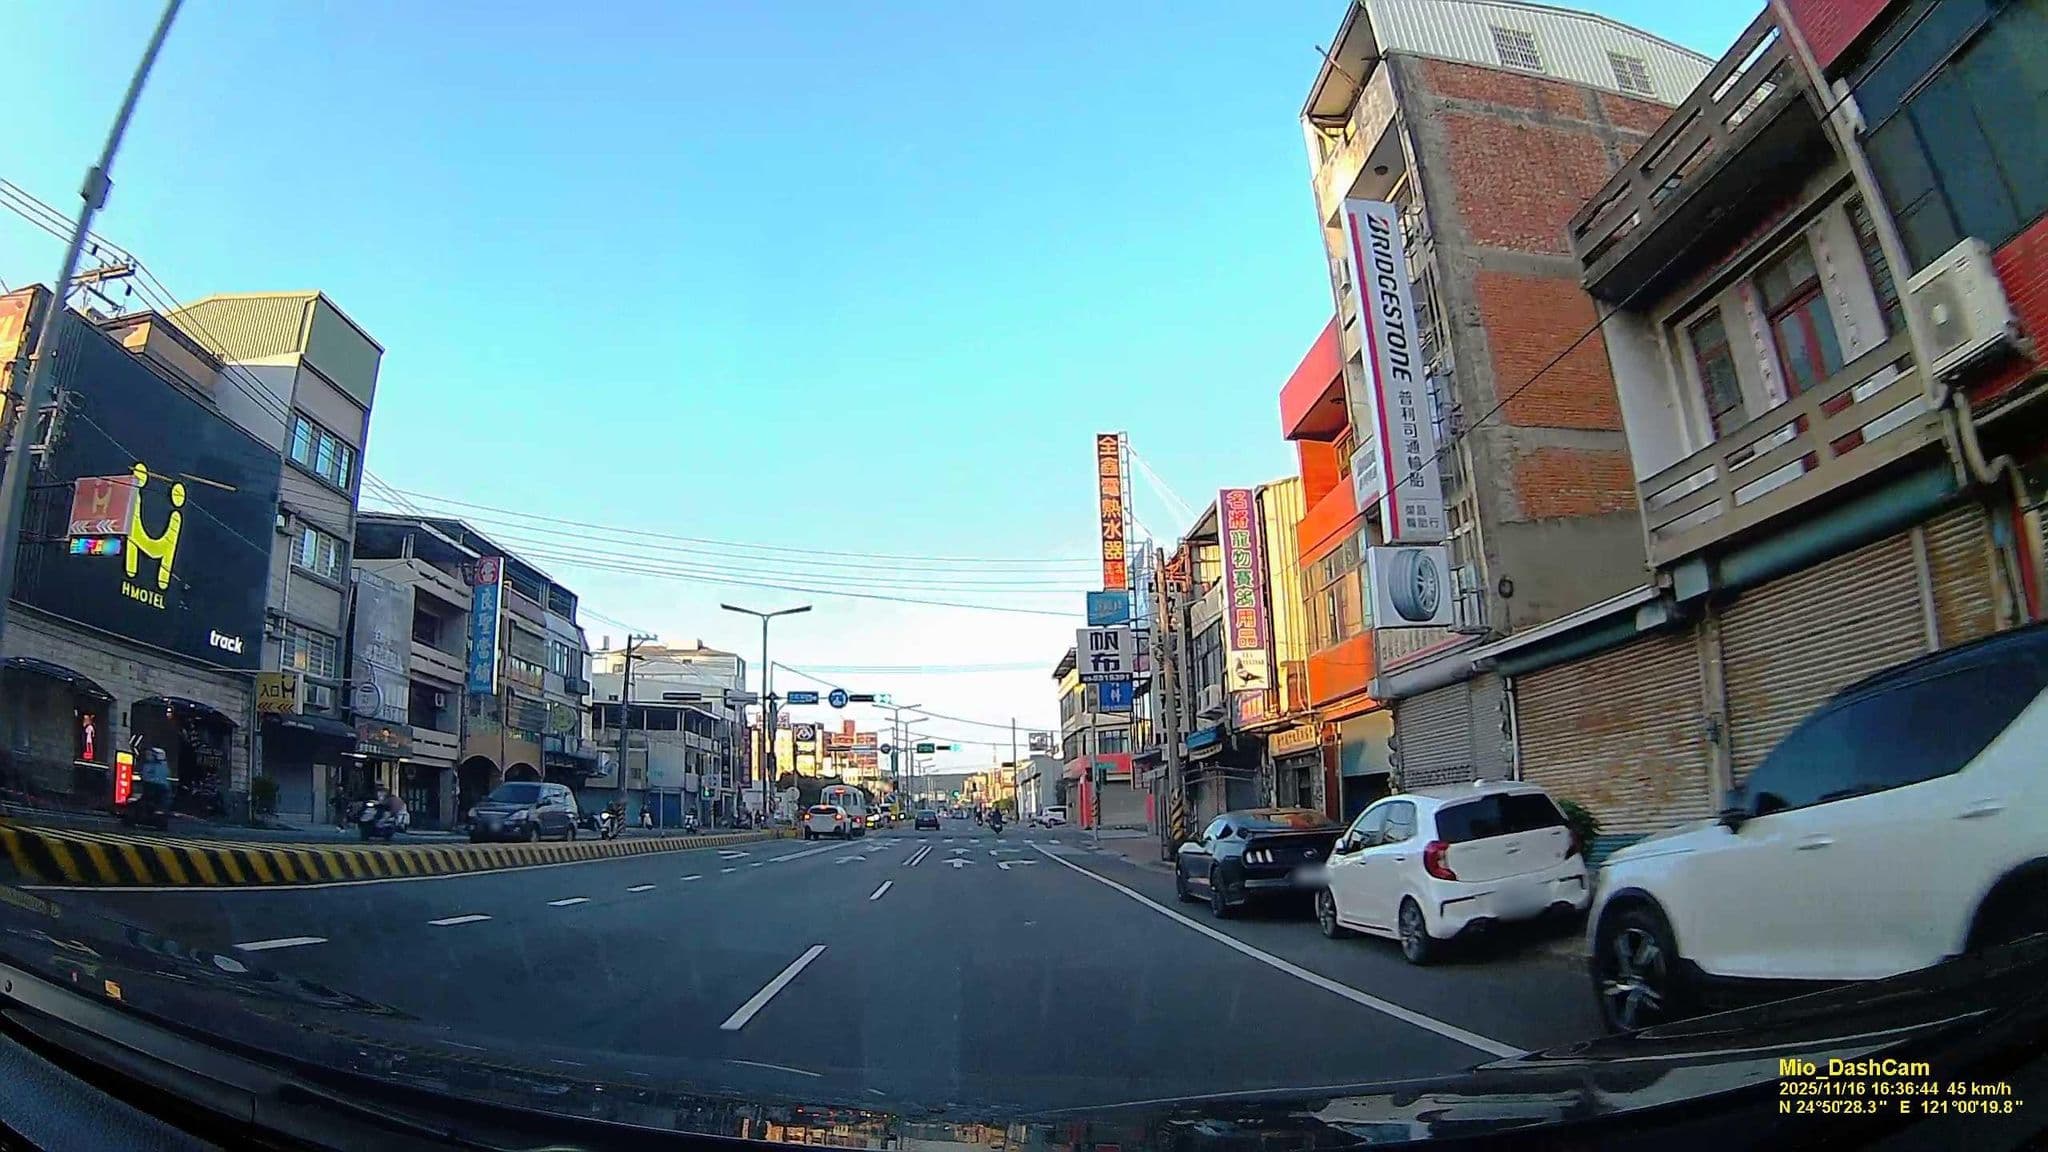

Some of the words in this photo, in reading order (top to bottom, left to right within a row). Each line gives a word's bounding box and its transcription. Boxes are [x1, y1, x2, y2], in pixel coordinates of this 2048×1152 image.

[1367, 213, 1412, 383] BRIDGESTONE
[209, 630, 245, 654] track
[1090, 632, 1120, 672] 帆布
